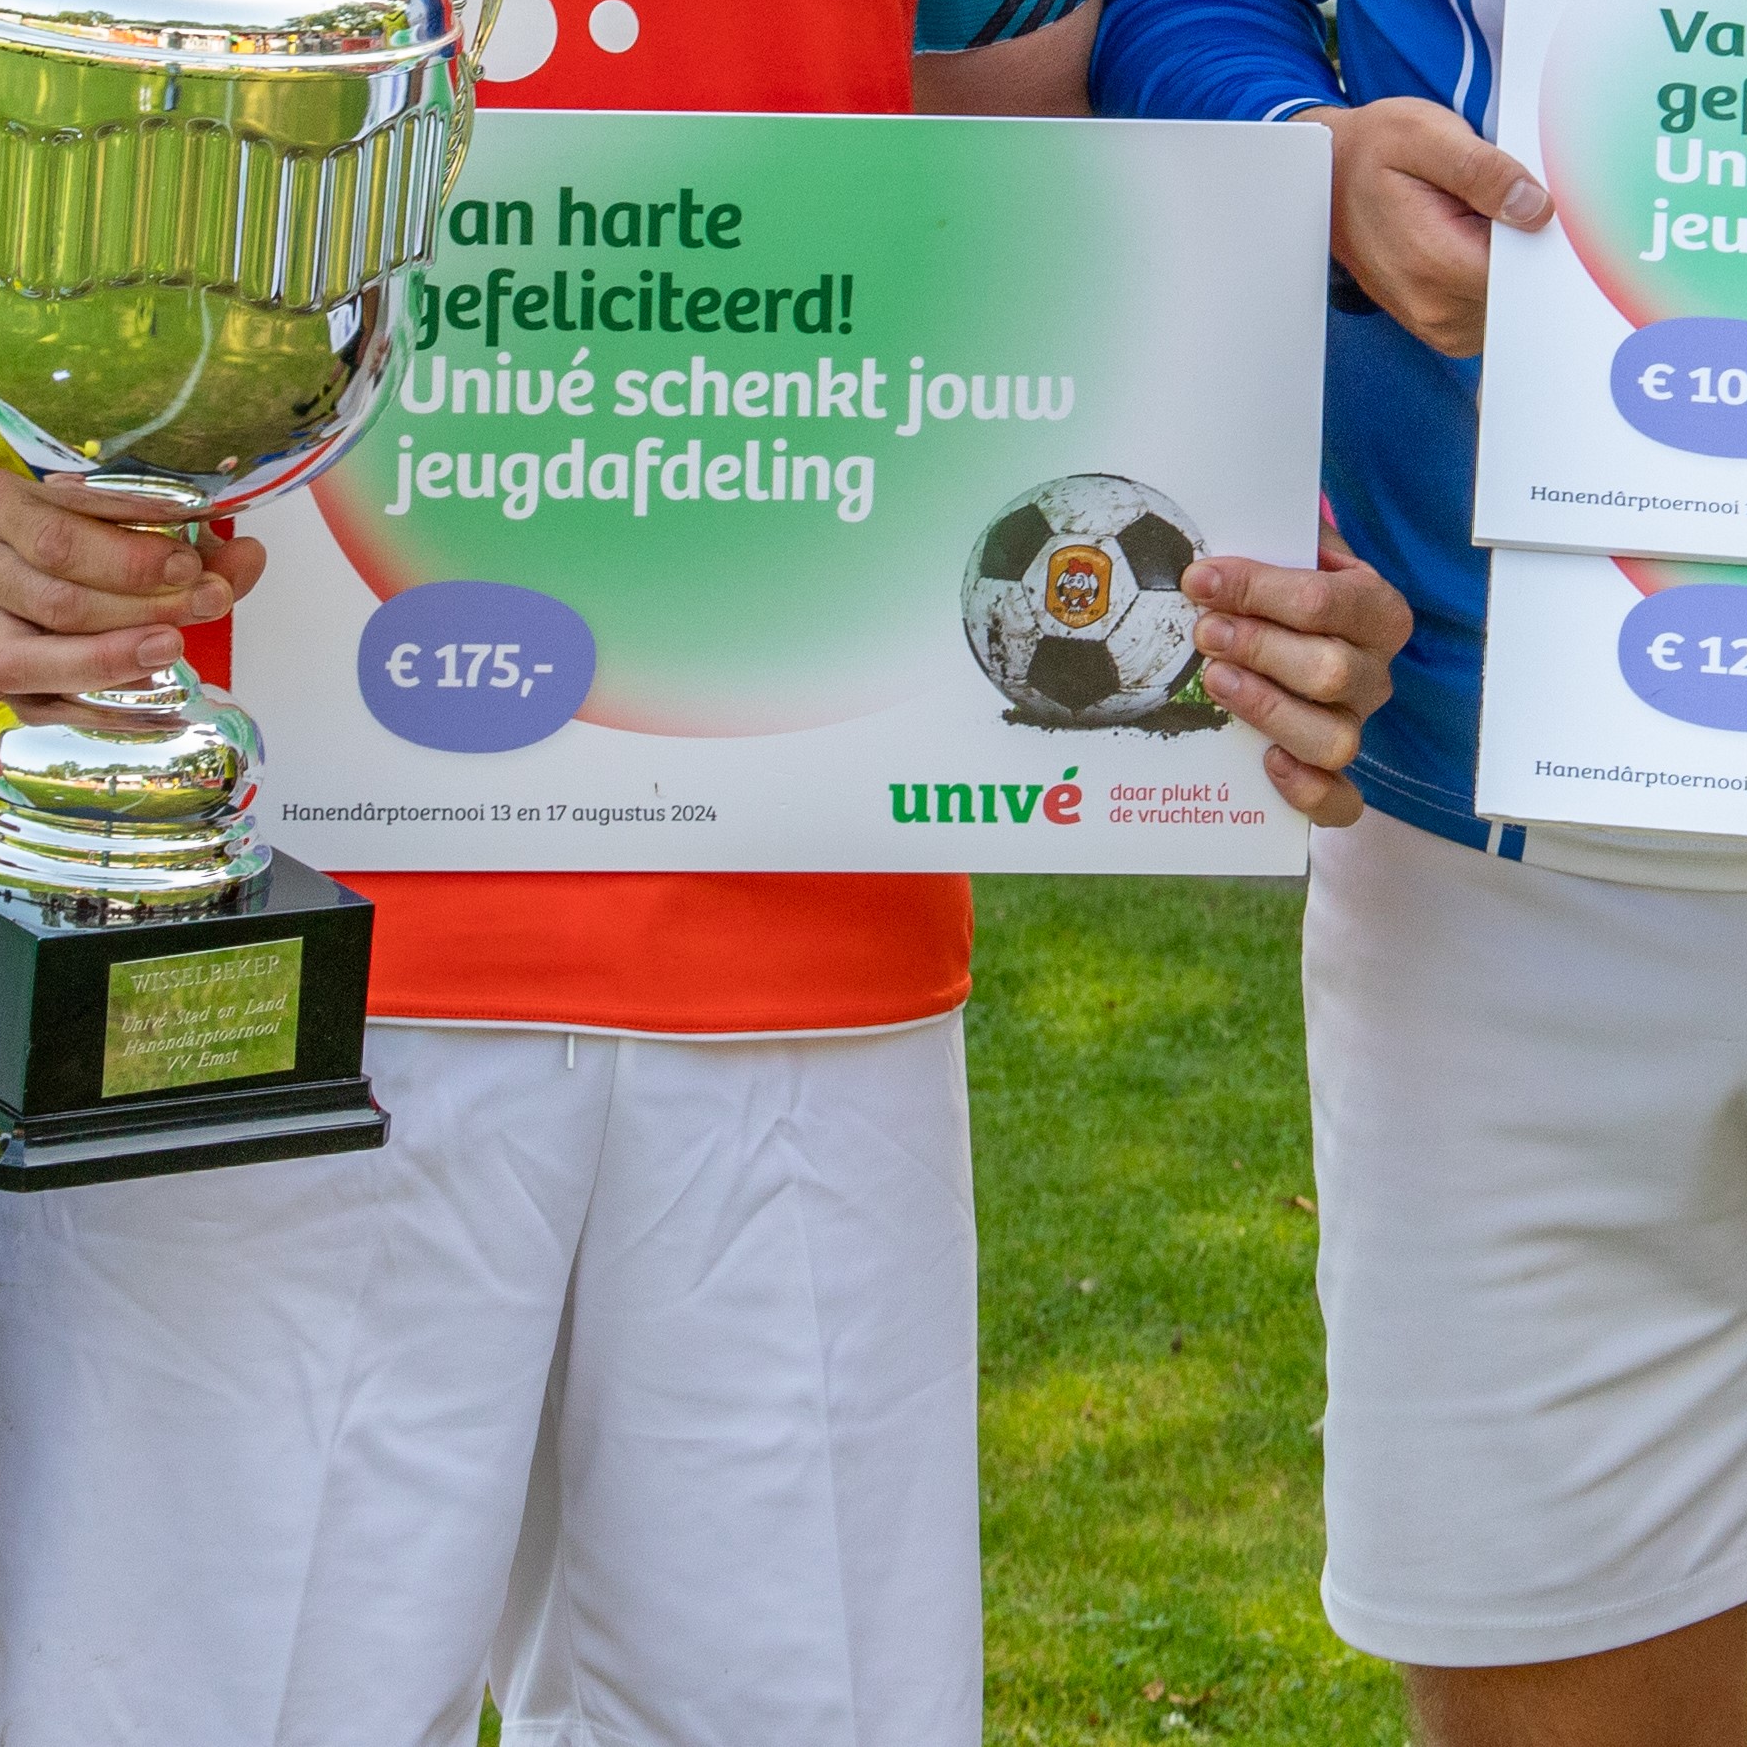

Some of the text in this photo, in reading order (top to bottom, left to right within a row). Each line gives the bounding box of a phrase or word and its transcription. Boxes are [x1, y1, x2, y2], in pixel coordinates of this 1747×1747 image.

[448, 187, 743, 249] an harte
[399, 347, 1076, 436] Univé schenkt jouw
[1637, 363, 1675, 402] €
[385, 436, 876, 523] jeugdafdeling
[1529, 485, 1740, 518] Hanendârptoernooi
[384, 643, 554, 699] € 175,-
[1646, 632, 1686, 672] €
[281, 801, 718, 827] Hanendârptoernooi 13 en 17 augustus 2024
[888, 766, 1083, 825] univé
[1110, 784, 1157, 802] daar
[1161, 784, 1213, 807] plukt
[1109, 807, 1265, 825] de vruchten van
[131, 955, 280, 993] WISSELBEKER
[122, 994, 287, 1033] Univé Stad en Land
[197, 1049, 239, 1069] Emst
